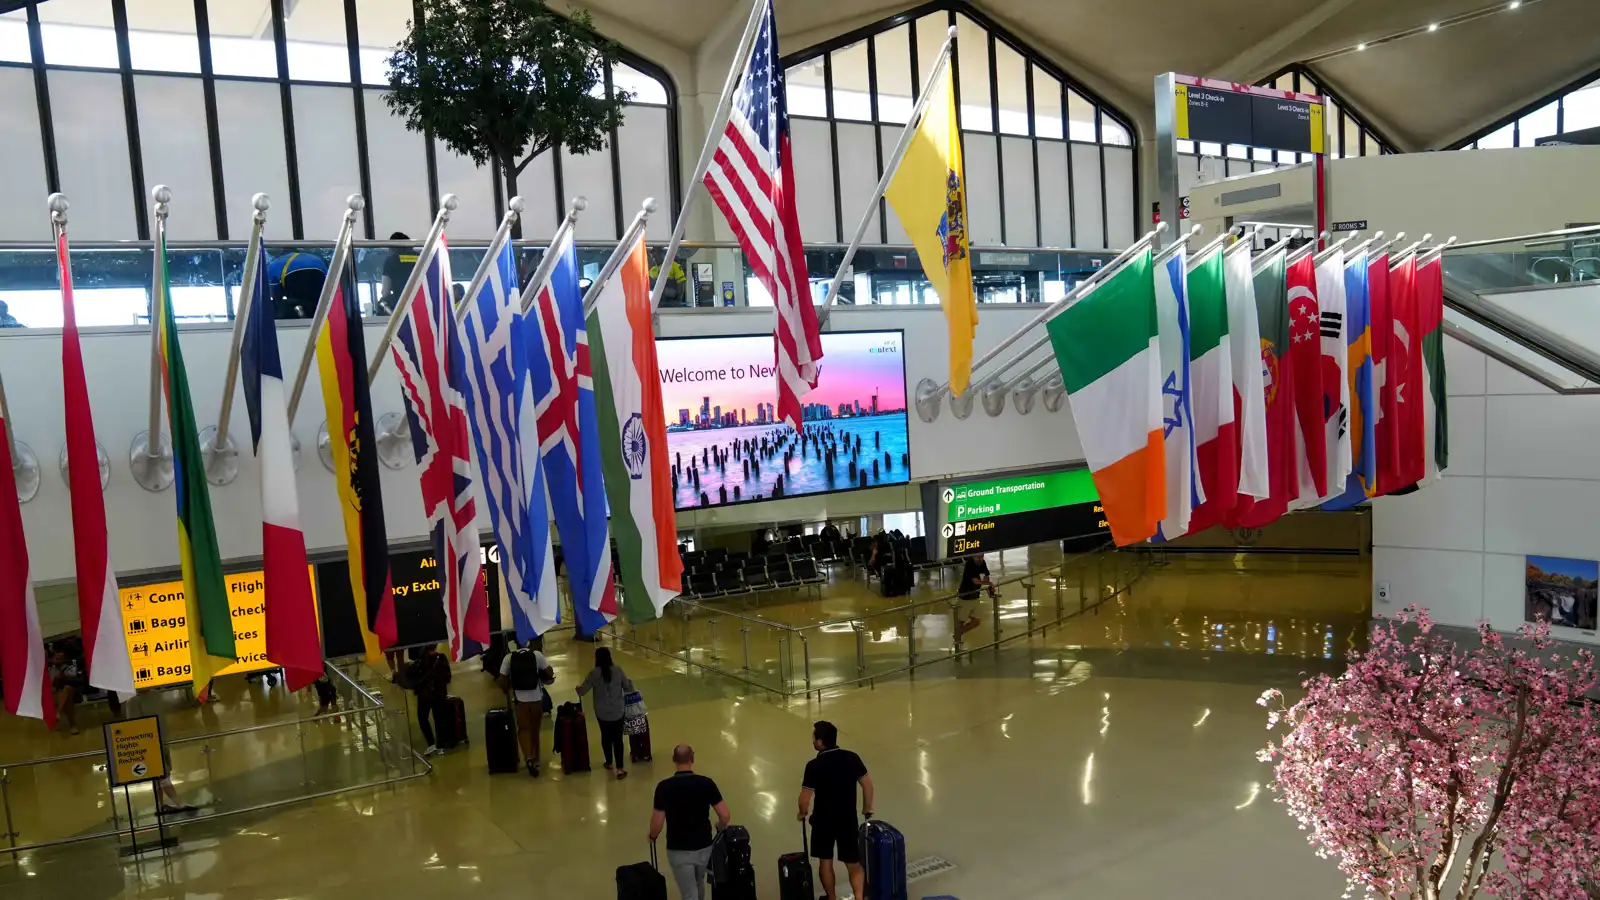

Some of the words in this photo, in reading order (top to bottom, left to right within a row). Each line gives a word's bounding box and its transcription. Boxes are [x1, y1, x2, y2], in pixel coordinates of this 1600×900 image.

[1188, 91, 1201, 99] Level
[1205, 93, 1225, 103] Check-in
[1278, 103, 1288, 111] Level
[1293, 105, 1309, 113] Check-in
[1339, 222, 1357, 230] ROOMS
[660, 366, 726, 383] Welcome
[730, 367, 745, 379] to
[967, 487, 994, 498] Ground
[995, 481, 1045, 494] Transportation
[967, 504, 994, 515] Parking
[1093, 505, 1104, 513] Res
[966, 521, 995, 532] AirTrain
[966, 540, 980, 550] Exit
[412, 579, 440, 592] Exch
[149, 592, 185, 604] Conn
[231, 580, 264, 594] Fligh
[151, 616, 186, 628] Bagg
[234, 630, 258, 641] ices
[157, 664, 191, 677] Bagg
[236, 652, 267, 664] rvice
[116, 733, 154, 742] Connecting
[118, 748, 147, 757] Baggage
[119, 756, 145, 764] Recheck
